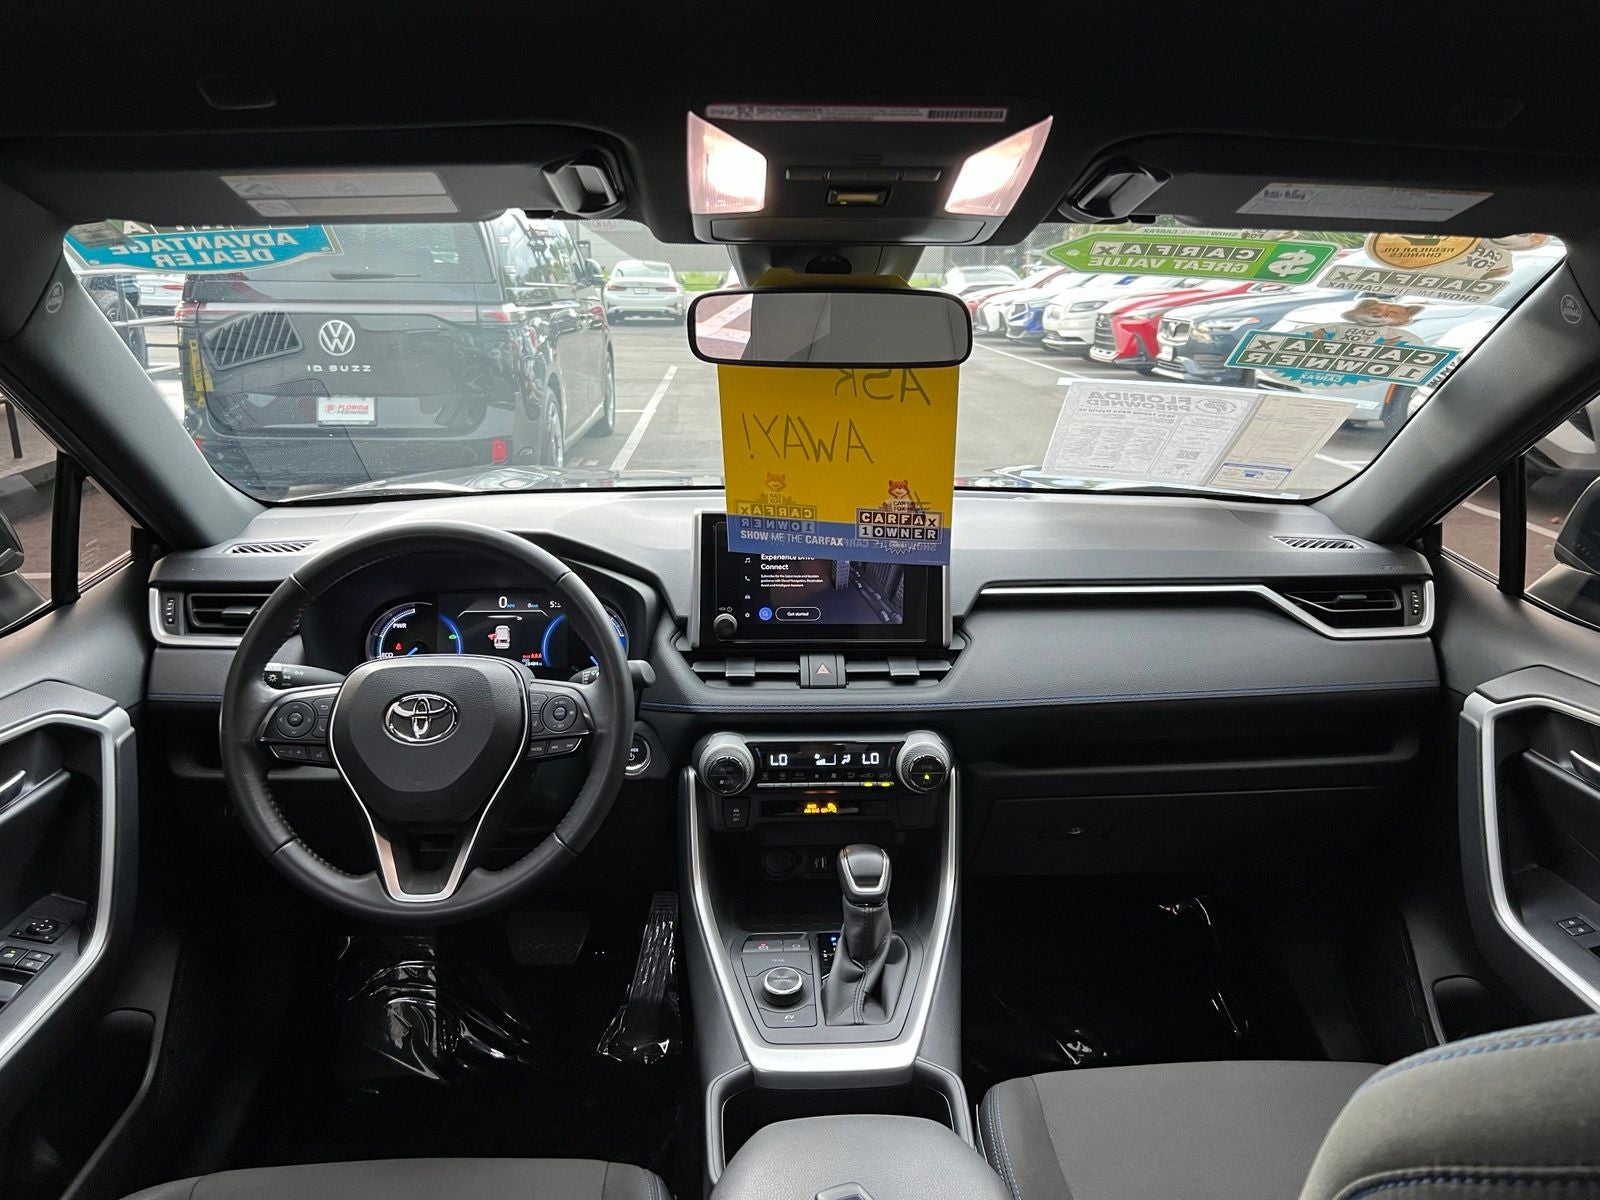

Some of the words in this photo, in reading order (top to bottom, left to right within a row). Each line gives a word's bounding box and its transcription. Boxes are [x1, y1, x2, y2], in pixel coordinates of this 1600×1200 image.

[328, 364, 372, 372] BUZZ
[336, 403, 369, 411] FLORIDA
[861, 512, 937, 527] CARFAX
[740, 530, 769, 542] SHOW
[771, 532, 785, 543] ME
[786, 533, 803, 544] THE
[804, 535, 844, 547] CARFAX
[874, 527, 937, 539] OWNER
[760, 563, 790, 571] Connect
[498, 595, 508, 609] 0
[769, 753, 789, 767] LO
[861, 751, 880, 765] LO
